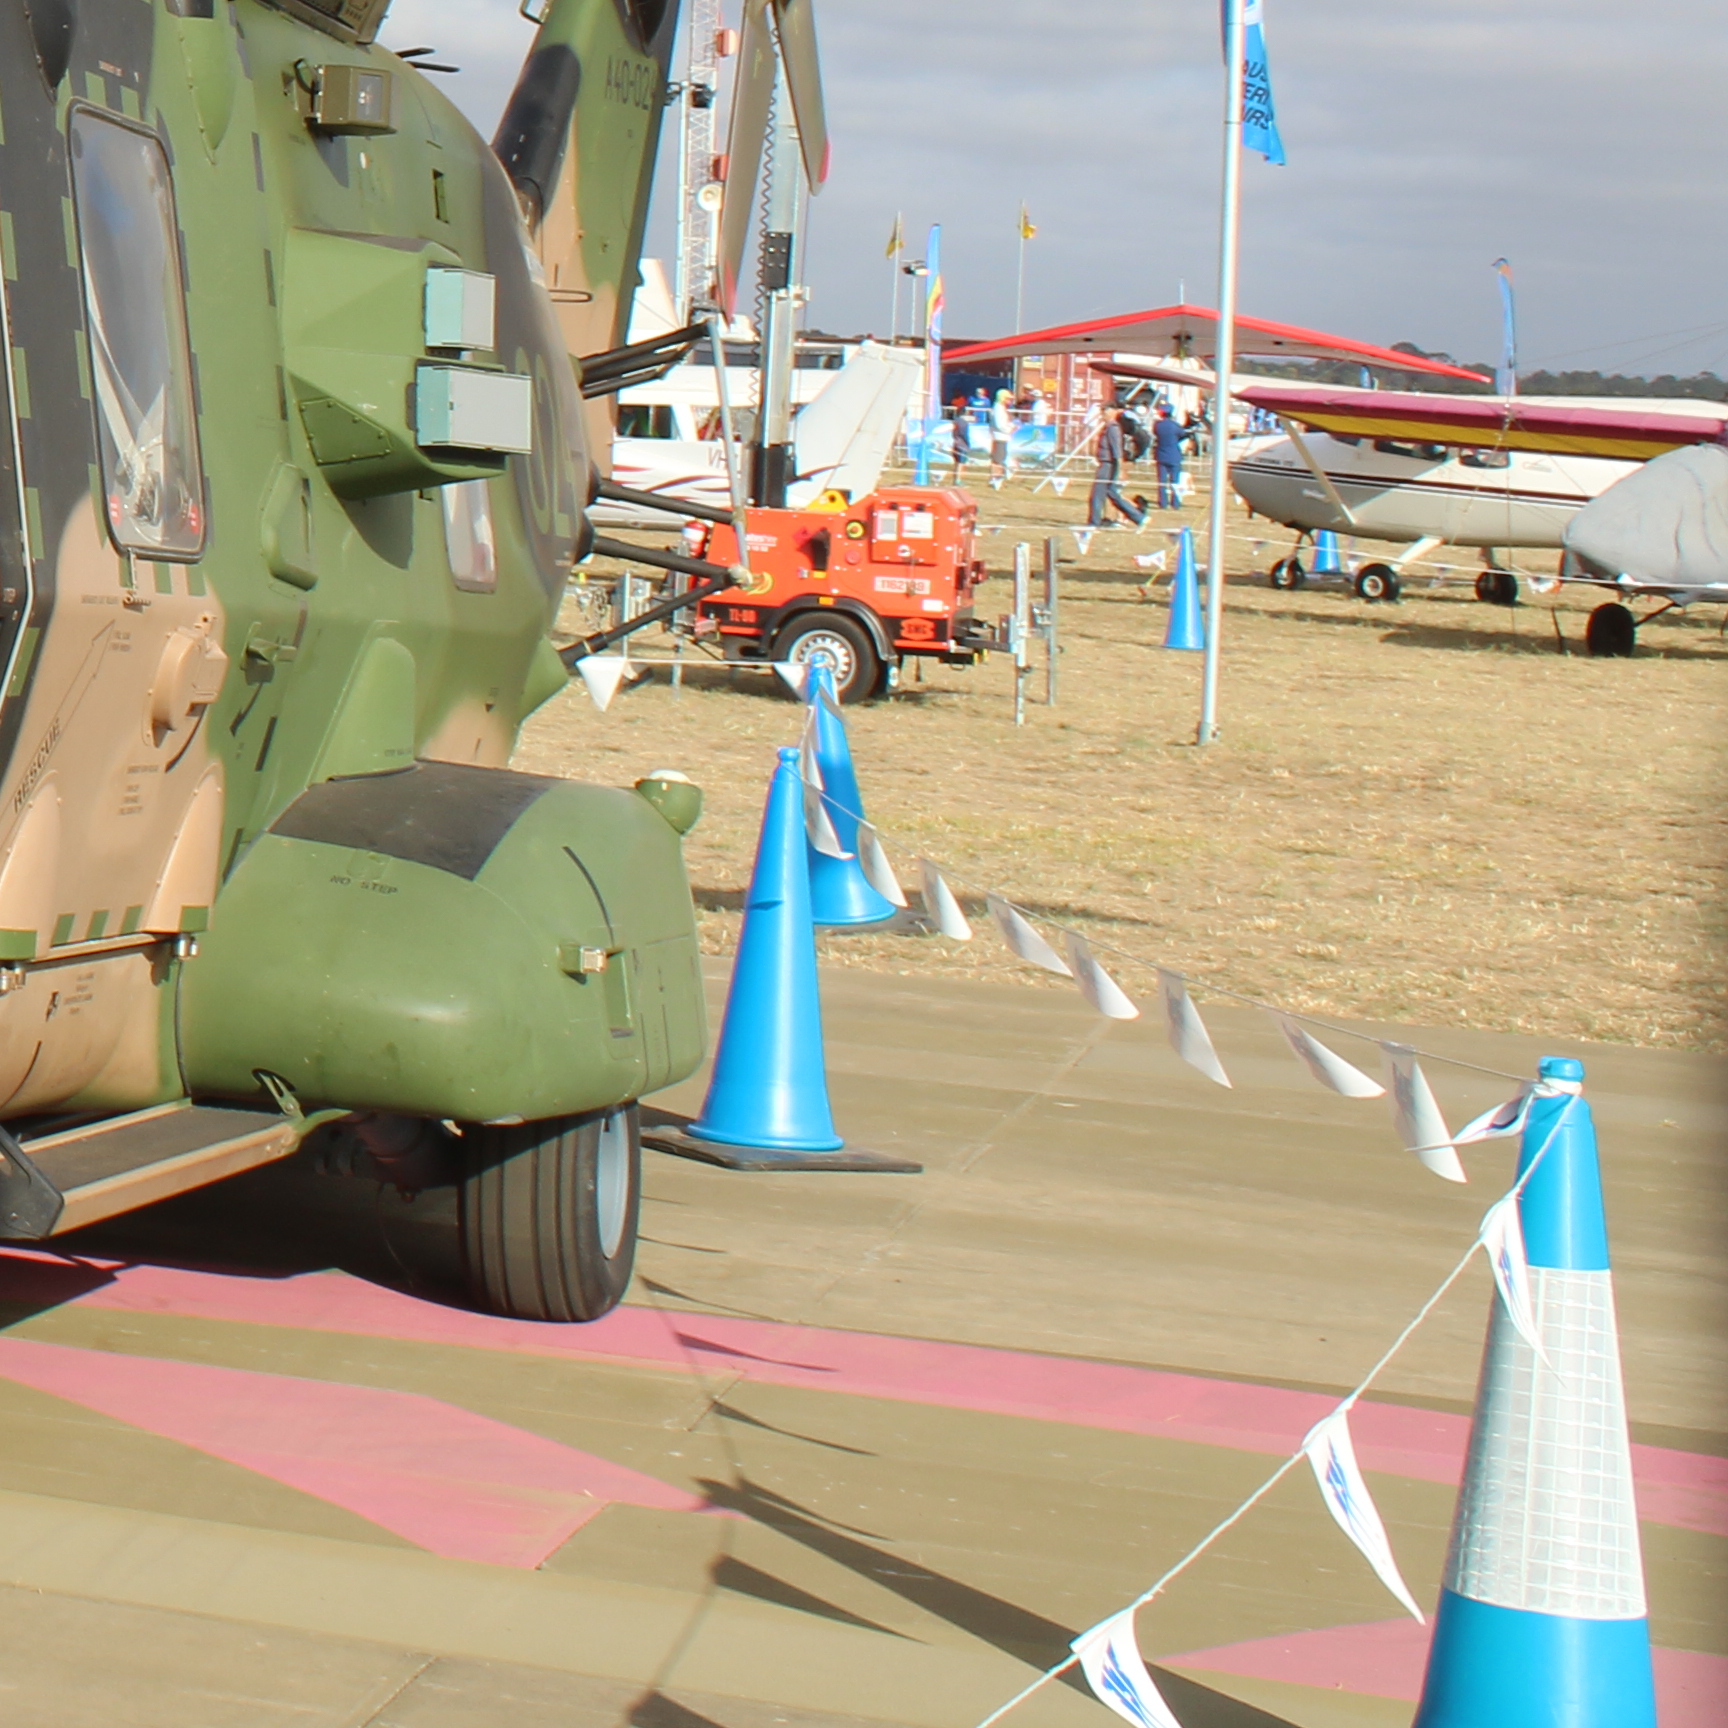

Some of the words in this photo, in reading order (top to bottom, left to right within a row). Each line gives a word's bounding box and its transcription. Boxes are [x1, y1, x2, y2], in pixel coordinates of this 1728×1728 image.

[12, 718, 61, 814] RESCUE
[330, 875, 351, 885] NO
[360, 881, 398, 895] STEP
